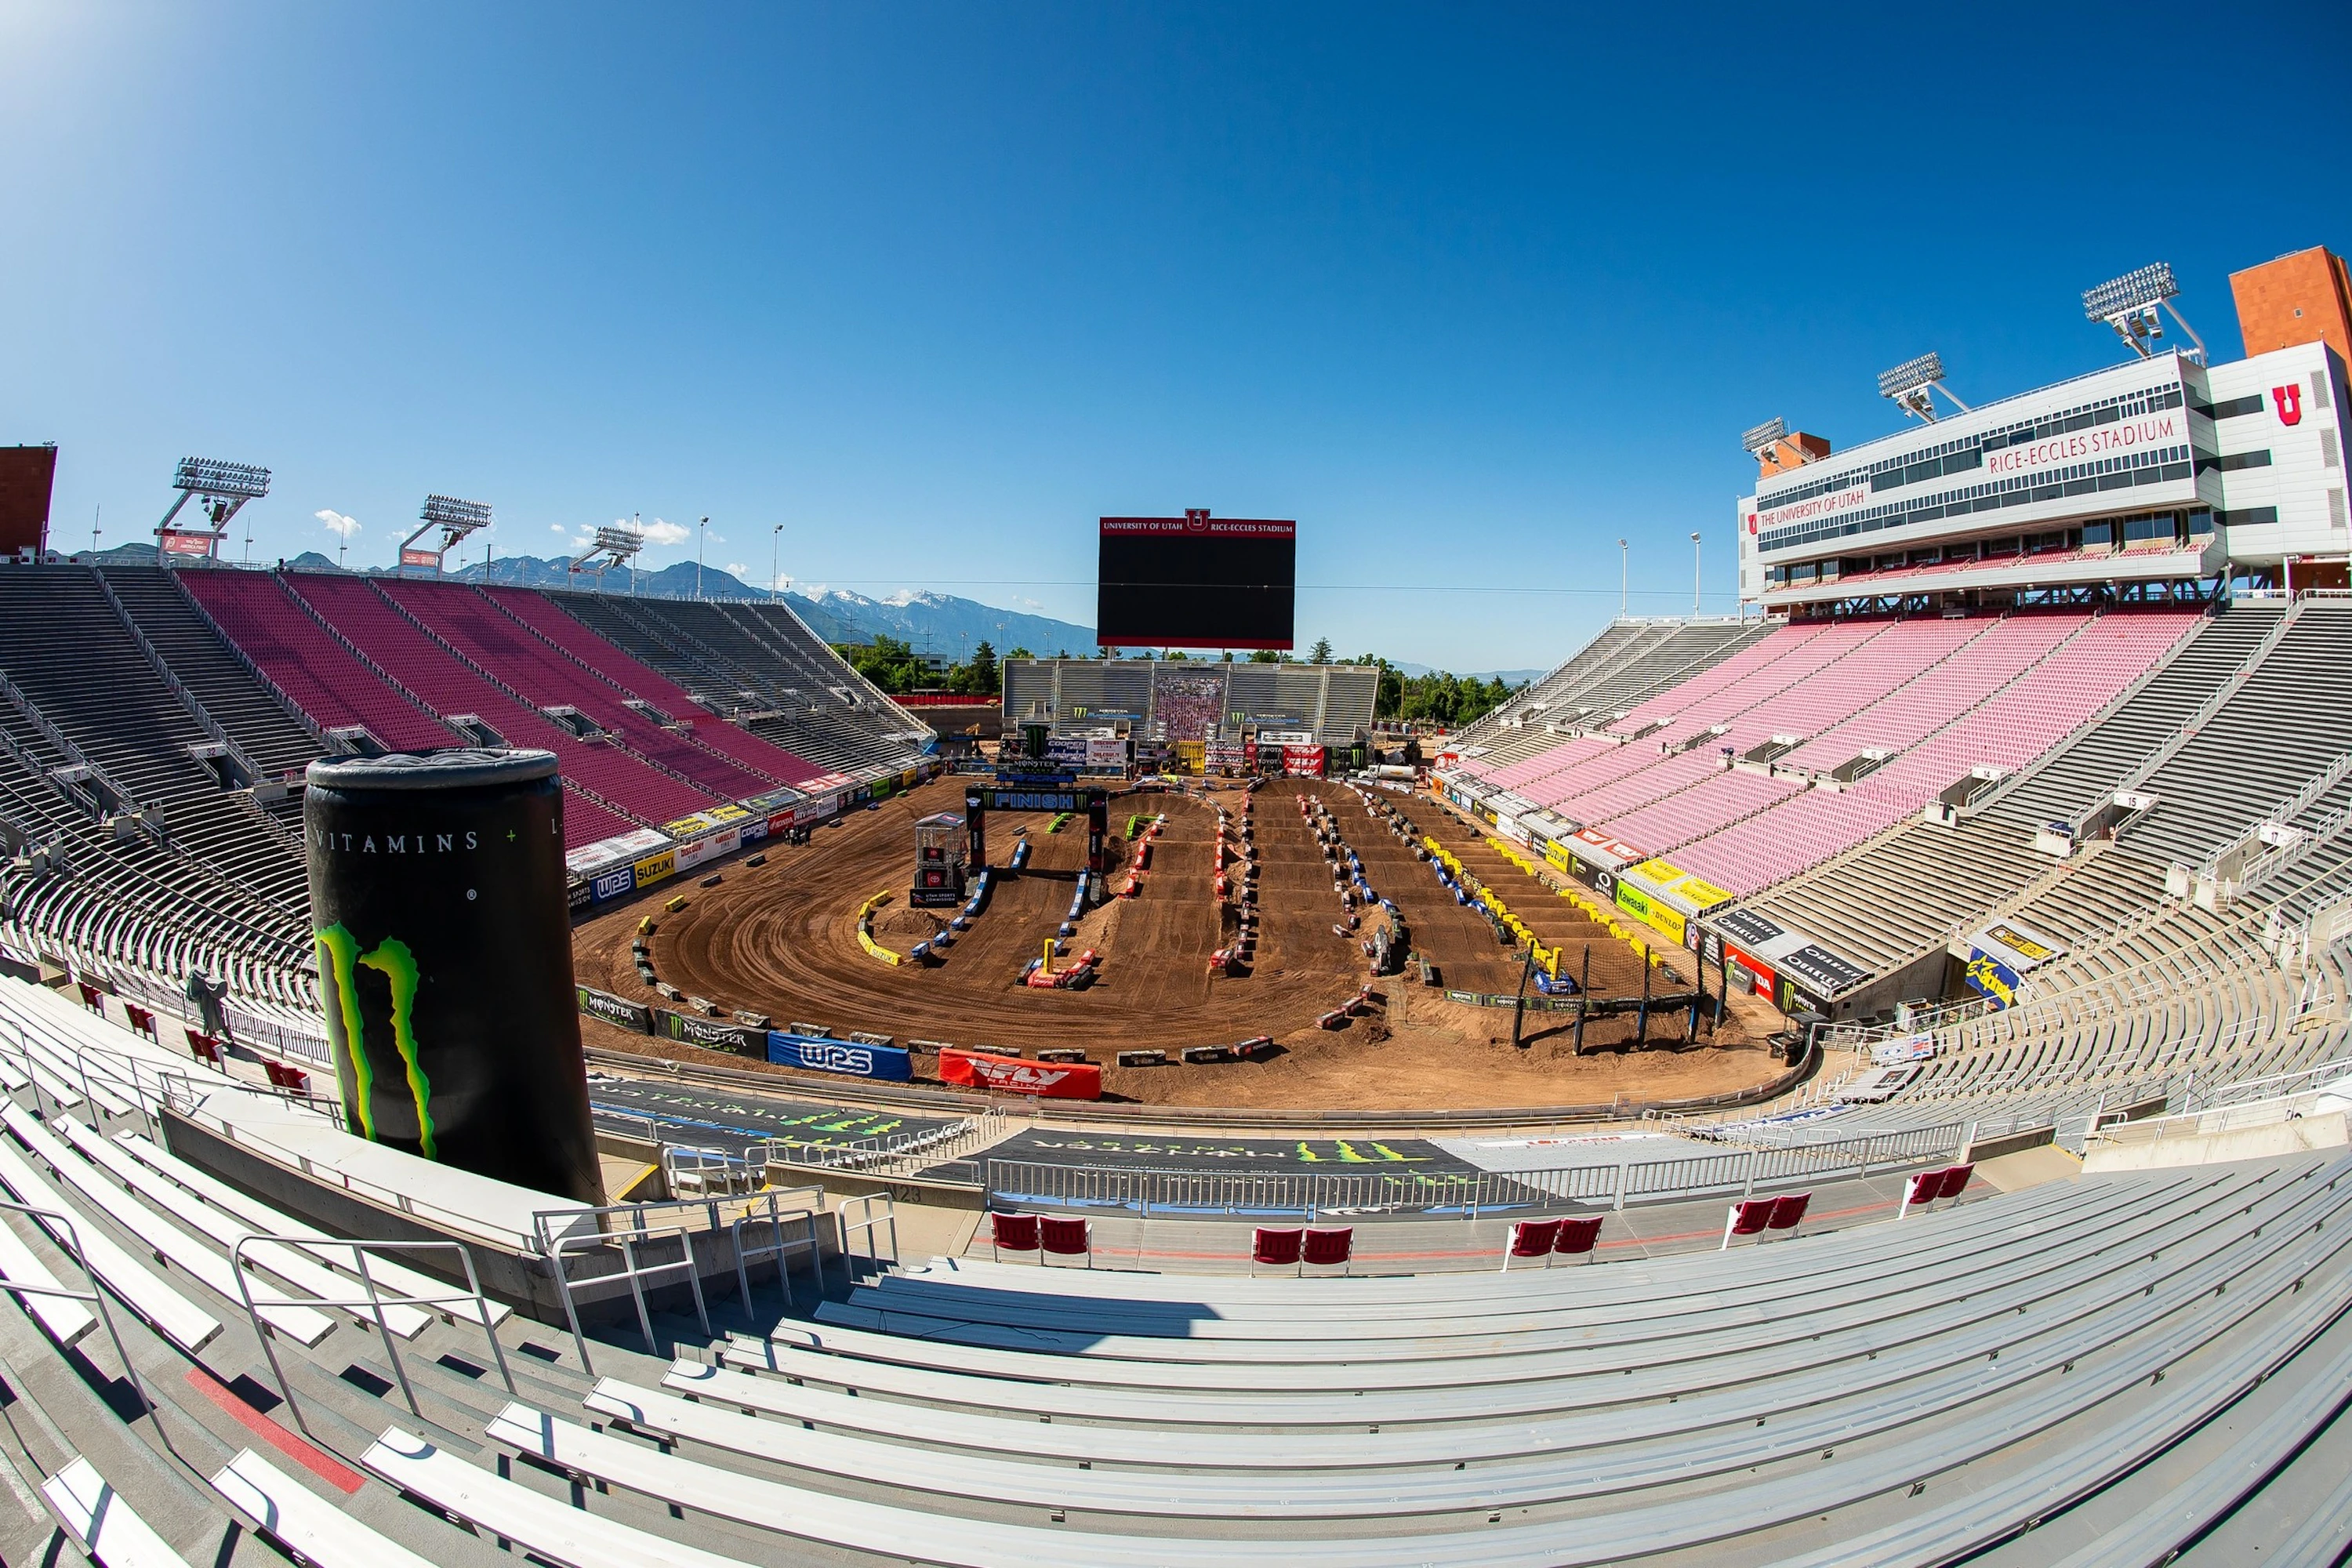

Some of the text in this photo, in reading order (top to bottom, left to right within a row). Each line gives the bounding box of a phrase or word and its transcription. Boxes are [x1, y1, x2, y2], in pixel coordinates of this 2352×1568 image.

[2272, 383, 2301, 426] U
[1990, 417, 2174, 474] RICE-ECCLES STADIUM
[1185, 508, 1210, 532] U
[1761, 489, 1864, 527] THE UNIVERSITY OF UTAH
[1210, 524, 1293, 533] RICE-ECCLES STADIUM
[206, 748, 216, 757] 32
[994, 792, 1074, 809] FINISH
[2129, 797, 2136, 807] 15
[315, 829, 477, 854] VITAMINS
[741, 822, 768, 837] COOPER
[2270, 831, 2279, 844] 17
[681, 841, 704, 858] DISCOUNT
[637, 856, 674, 881] SUZUKI
[597, 869, 631, 899] WPS
[1618, 887, 1648, 916] Kawasaki
[1655, 911, 1682, 931] DUNLOP
[1719, 917, 1761, 943] OAKLEY
[1734, 910, 1779, 935] OAKLEY
[1788, 955, 1842, 986] OAKLEY
[1805, 948, 1861, 978] OAKLEY
[589, 996, 634, 1020] MONSTER
[684, 1022, 746, 1047] MONSTER
[799, 1041, 873, 1075] WPS
[967, 1058, 1071, 1085] FLY
[987, 1078, 1047, 1091] RACING
